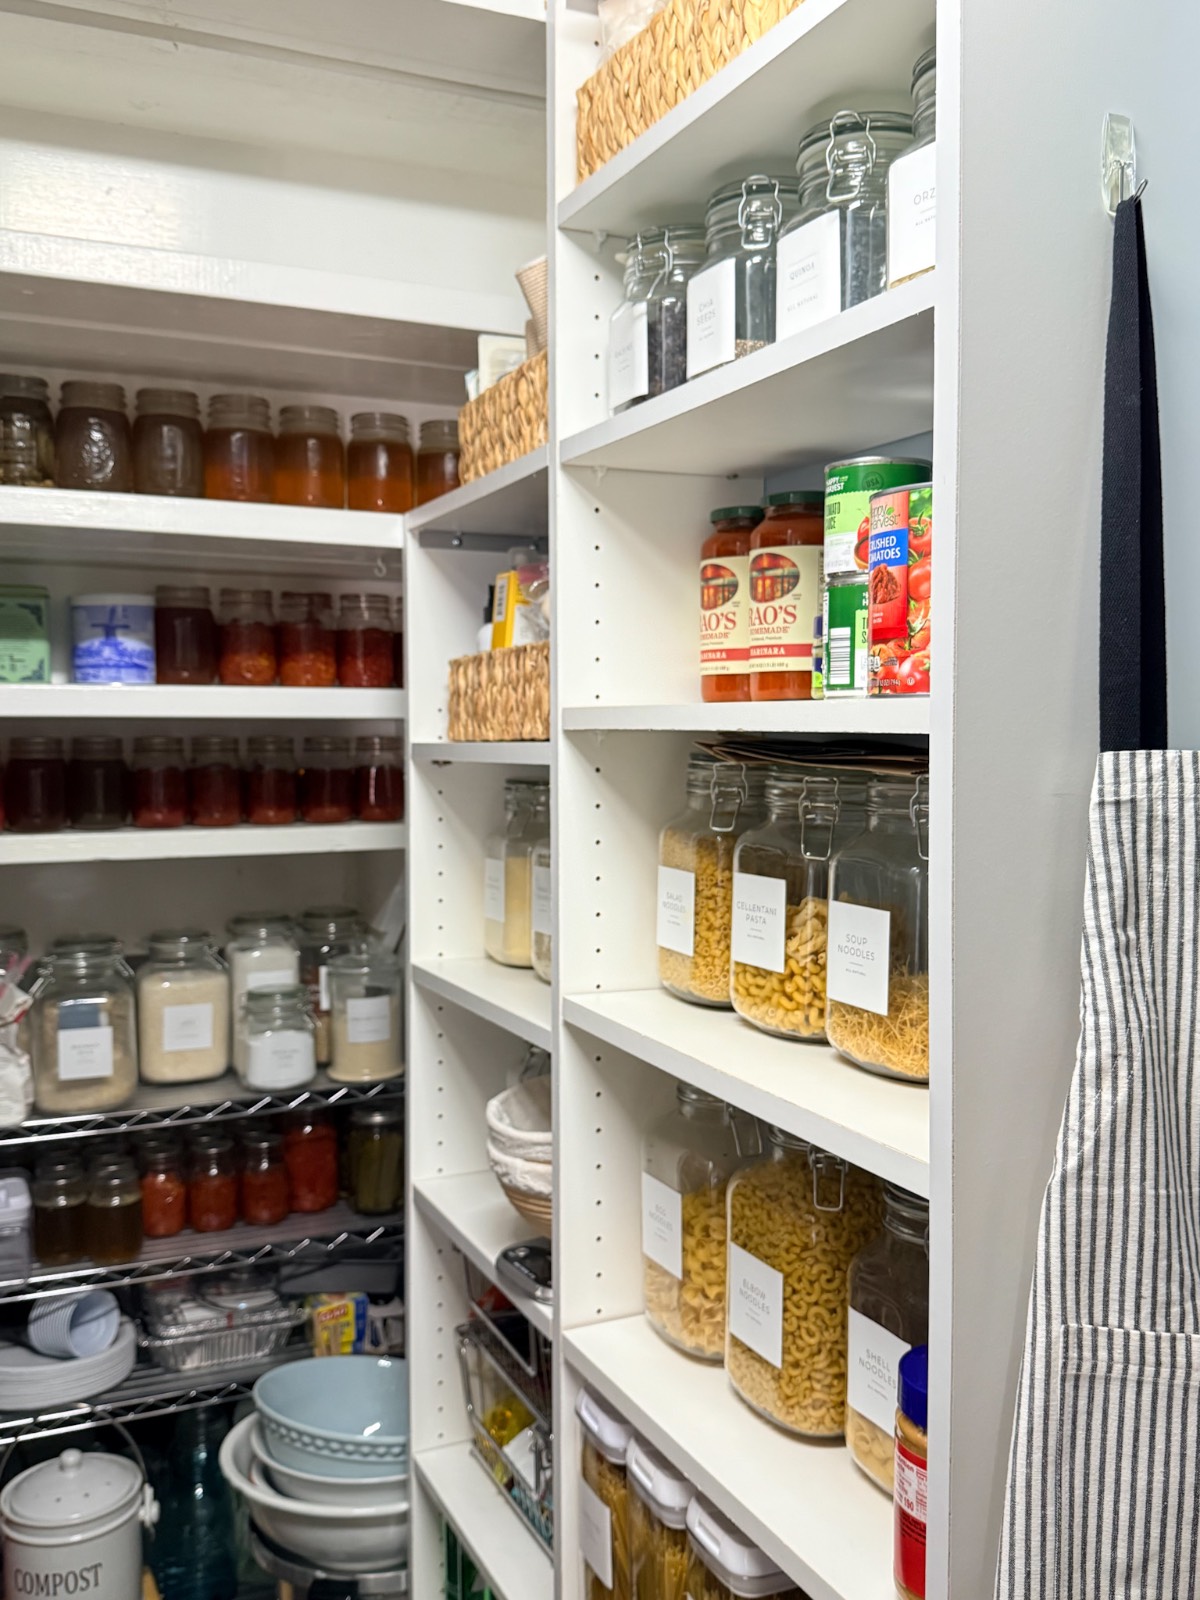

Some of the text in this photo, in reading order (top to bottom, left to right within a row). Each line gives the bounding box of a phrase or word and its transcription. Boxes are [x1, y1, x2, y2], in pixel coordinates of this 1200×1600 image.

[914, 187, 936, 205] ORZ
[789, 261, 815, 280] QUINOA
[866, 477, 880, 489] USA
[826, 501, 840, 516] OMATO
[871, 504, 888, 520] appy
[869, 547, 901, 563] OMATOES
[700, 612, 737, 632] AO'S
[701, 632, 729, 641] MEMADE
[750, 626, 789, 635] OMEMADE
[701, 651, 727, 660] RINARA
[662, 901, 686, 914] NOODLES
[736, 901, 777, 916] CELLENTANI
[745, 914, 767, 925] PASTA
[846, 933, 868, 945] SOUP
[837, 944, 875, 961] NOODLES
[743, 1278, 766, 1301] ELBOW
[739, 1287, 770, 1315] NOODLES
[866, 1348, 890, 1372] SHELL
[14, 1562, 103, 1597] COMPOST
